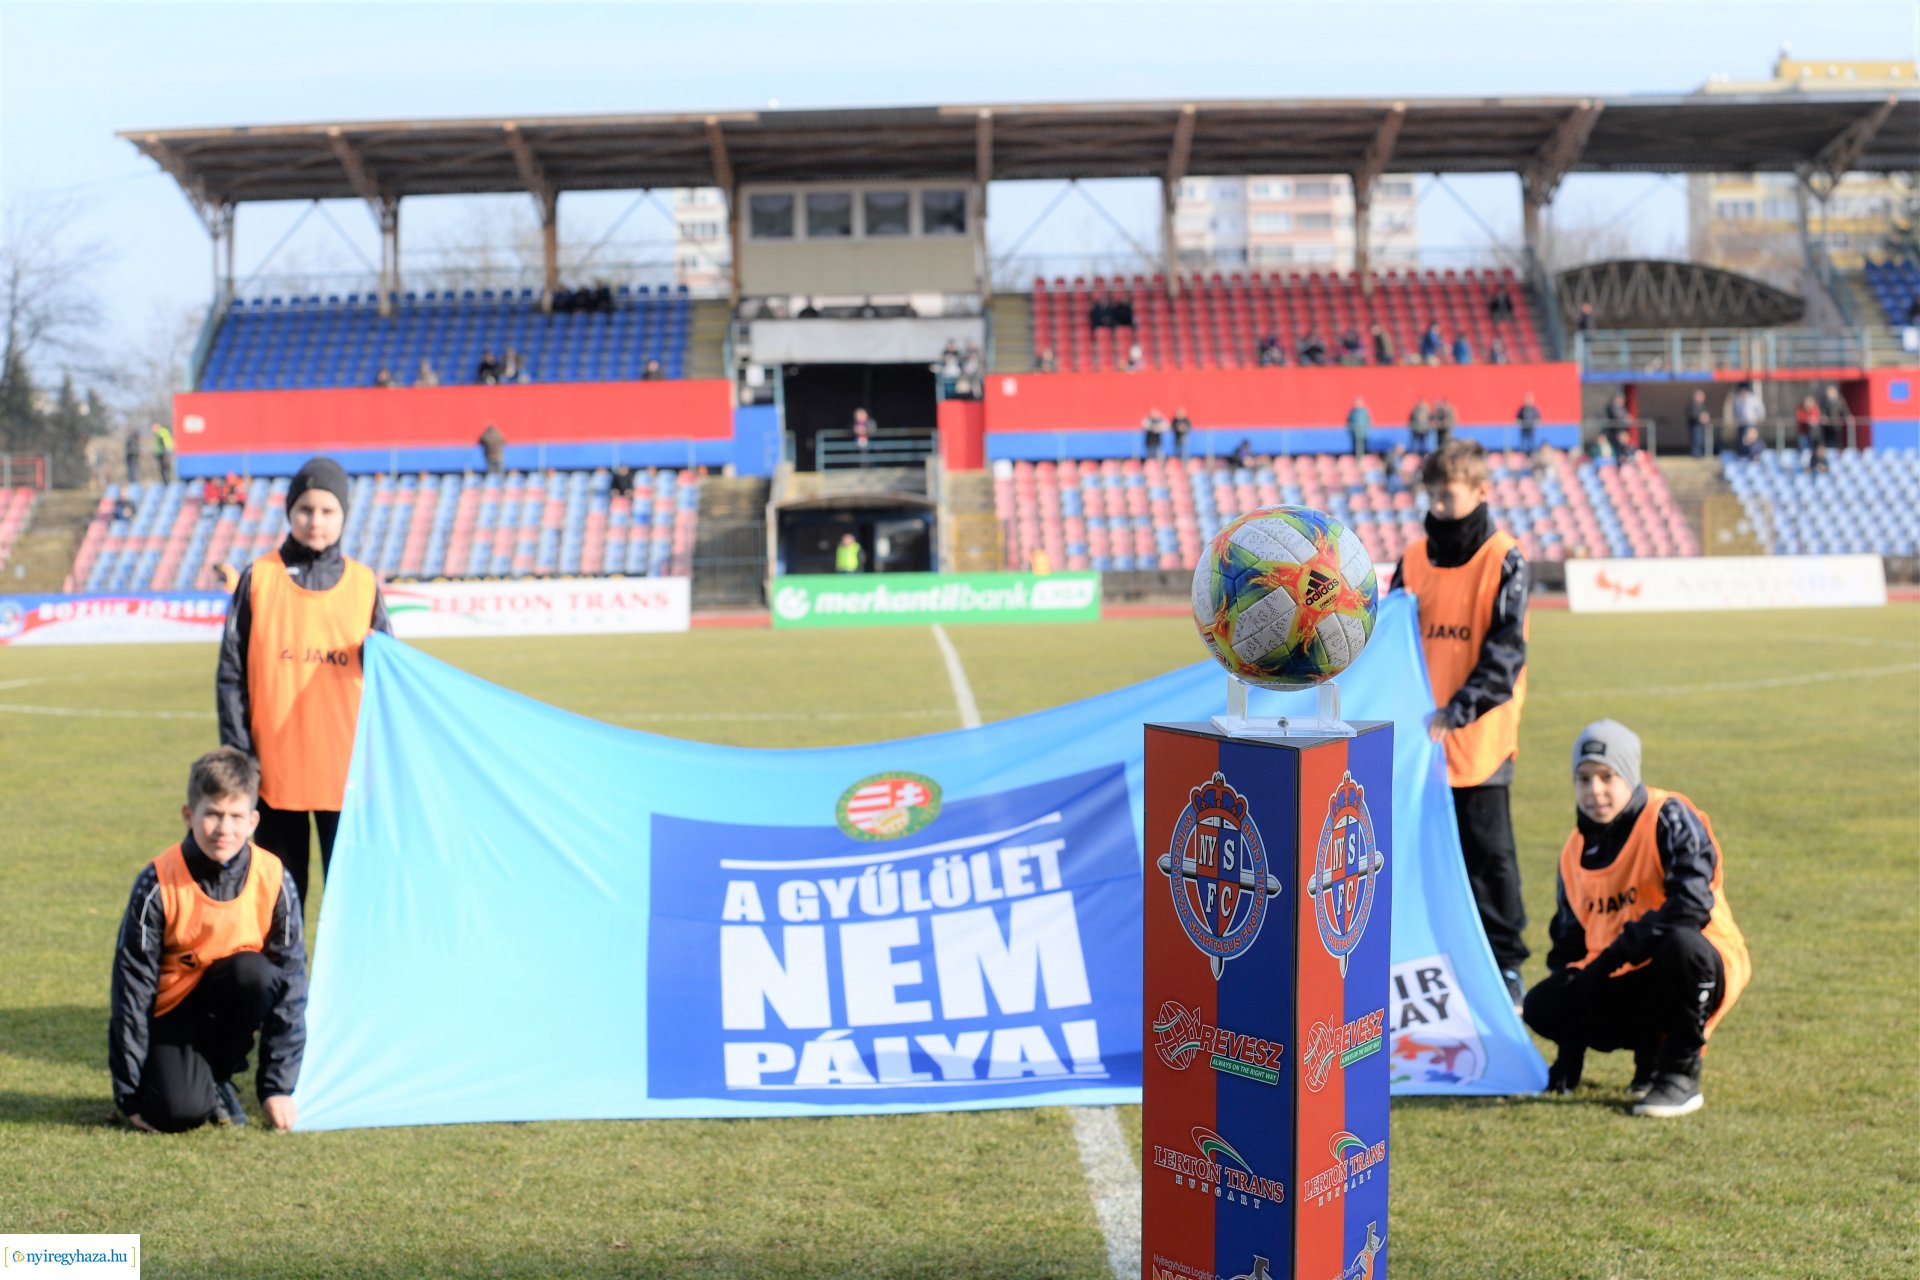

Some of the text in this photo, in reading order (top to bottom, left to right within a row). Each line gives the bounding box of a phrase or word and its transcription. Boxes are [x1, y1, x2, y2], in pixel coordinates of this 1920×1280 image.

[568, 589, 671, 609] TRANS
[815, 583, 1030, 613] merkantilbank
[1305, 578, 1339, 606] adidas
[1426, 624, 1471, 641] JAKO
[303, 648, 349, 666] JAKO
[1199, 834, 1235, 871] NY S
[1243, 822, 1263, 862] CLUB
[1333, 833, 1356, 871] NY S
[722, 838, 1066, 922] A GYŰLÖLET
[1337, 880, 1354, 916] F C
[1206, 883, 1233, 917] F C
[1242, 866, 1265, 942] FOOTBALL
[1598, 887, 1638, 914] JAKO
[1189, 921, 1241, 953] SPARTACUS
[720, 890, 1092, 1030] NEM
[1391, 967, 1448, 1001] IR
[1390, 993, 1451, 1032] AY
[723, 1019, 1107, 1088] PÁLYA!
[1212, 1058, 1277, 1081] ALWAYS ON THE RIGHT WAY
[1154, 1145, 1284, 1203] LERTON TRANS
[1304, 1140, 1386, 1202] LERTON TRANS
[1318, 1170, 1372, 1208] HUNGARY
[1175, 1175, 1261, 1209] HUNGARY
